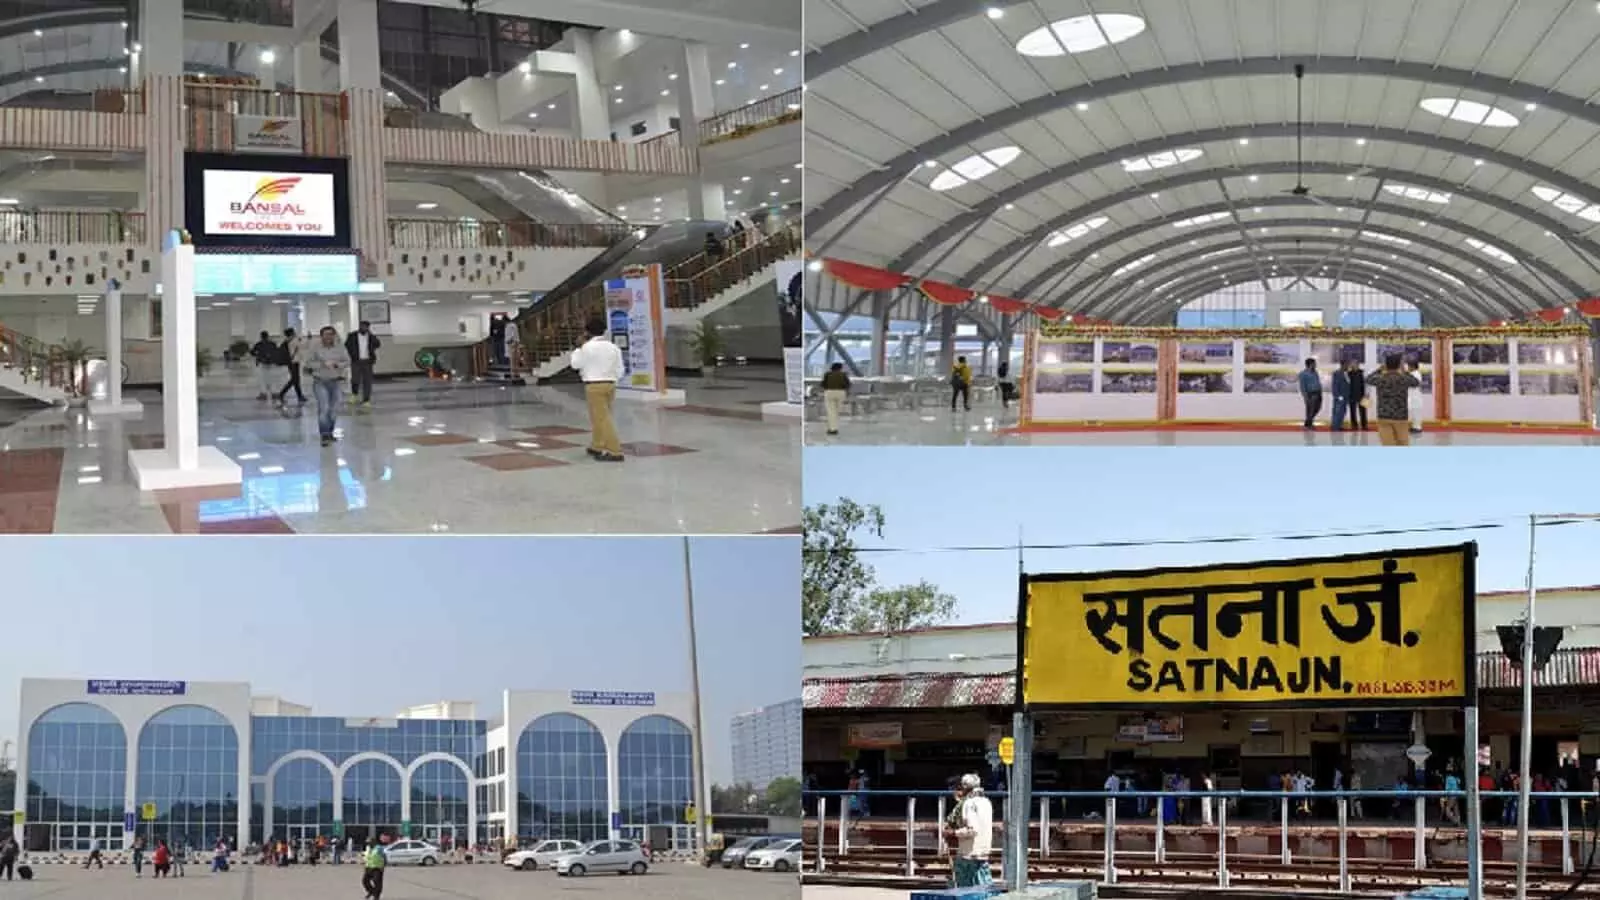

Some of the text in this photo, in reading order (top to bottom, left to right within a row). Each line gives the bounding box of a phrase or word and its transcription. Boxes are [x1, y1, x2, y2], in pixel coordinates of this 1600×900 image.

[230, 202, 305, 215] BANSAL
[219, 222, 322, 231] WELCOMES YOU
[1083, 578, 1315, 654] सतना
